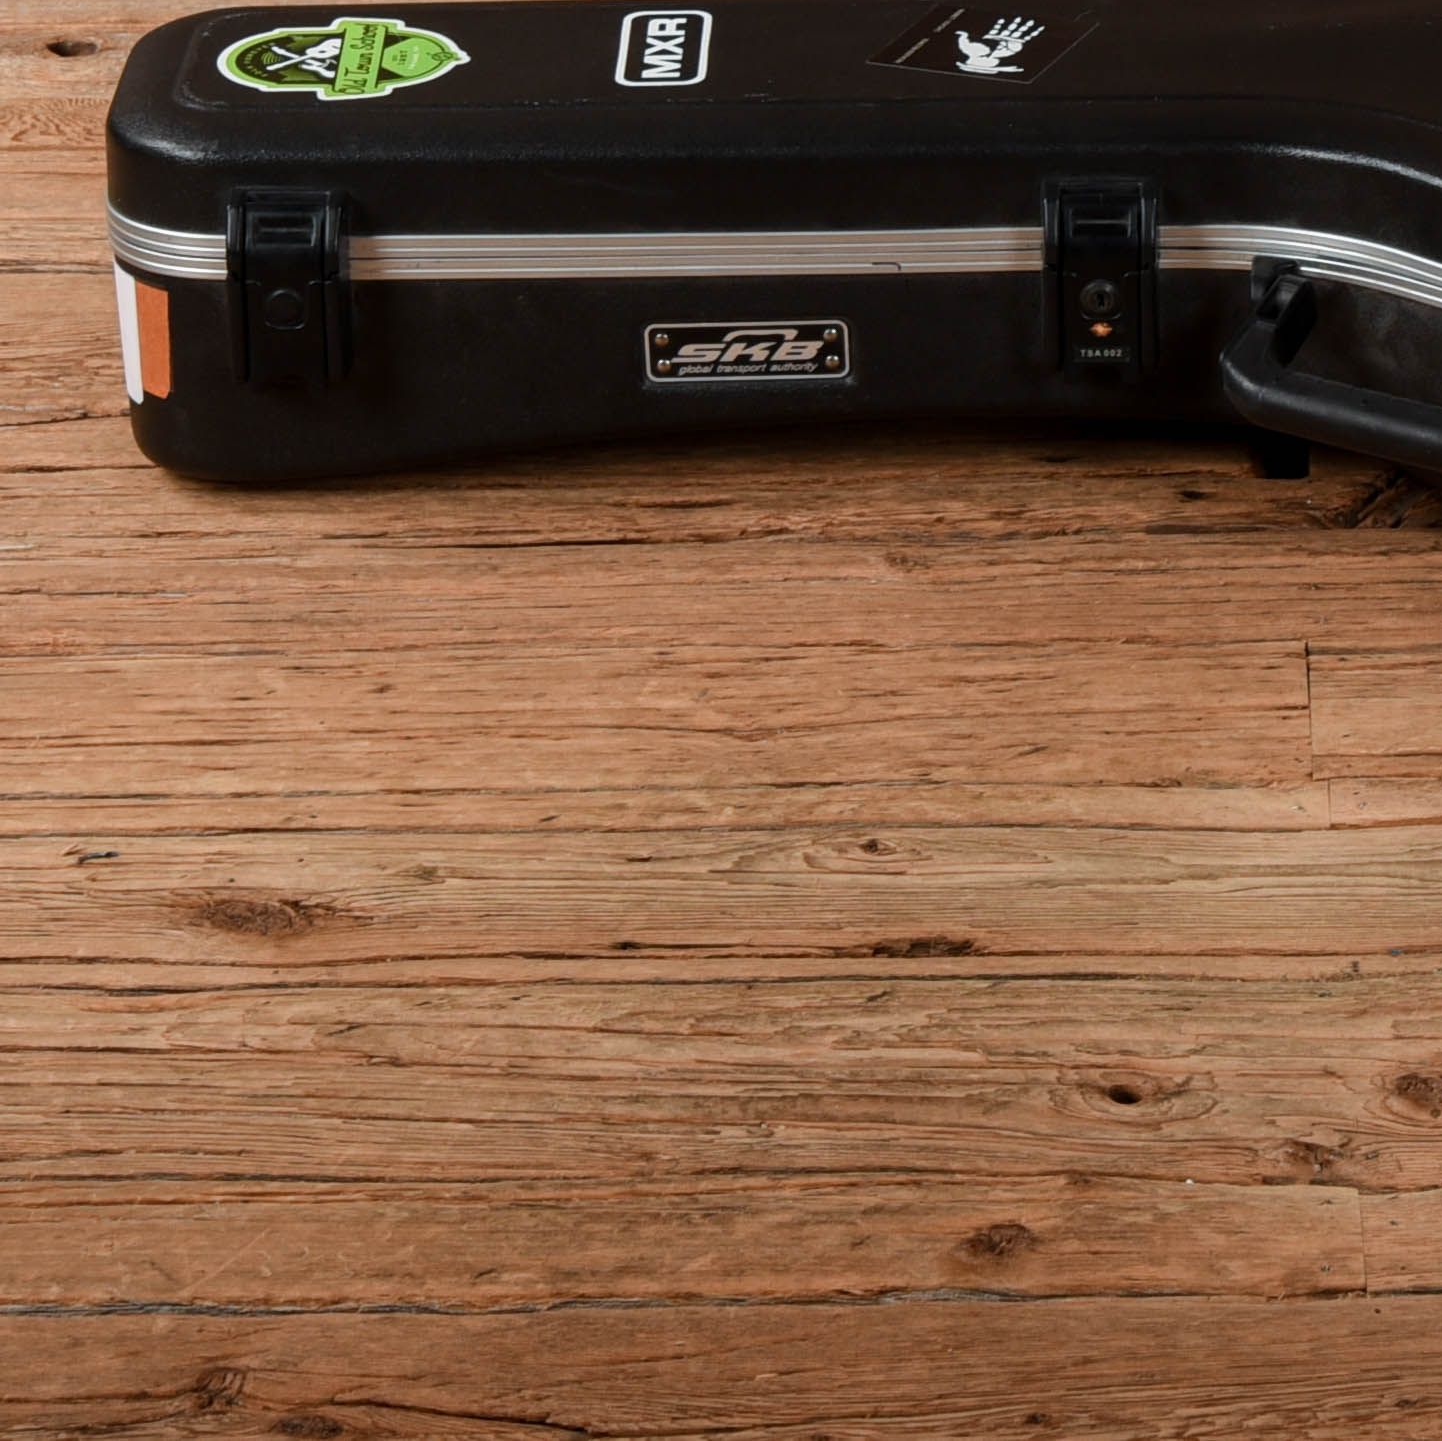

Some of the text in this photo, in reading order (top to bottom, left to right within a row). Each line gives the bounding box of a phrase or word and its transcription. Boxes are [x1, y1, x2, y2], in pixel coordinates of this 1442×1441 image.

[338, 24, 379, 95] Old Town School
[641, 17, 688, 79] MXR
[671, 340, 825, 364] SKB
[1080, 349, 1123, 358] TSA 002
[677, 361, 819, 376] global transport authority
